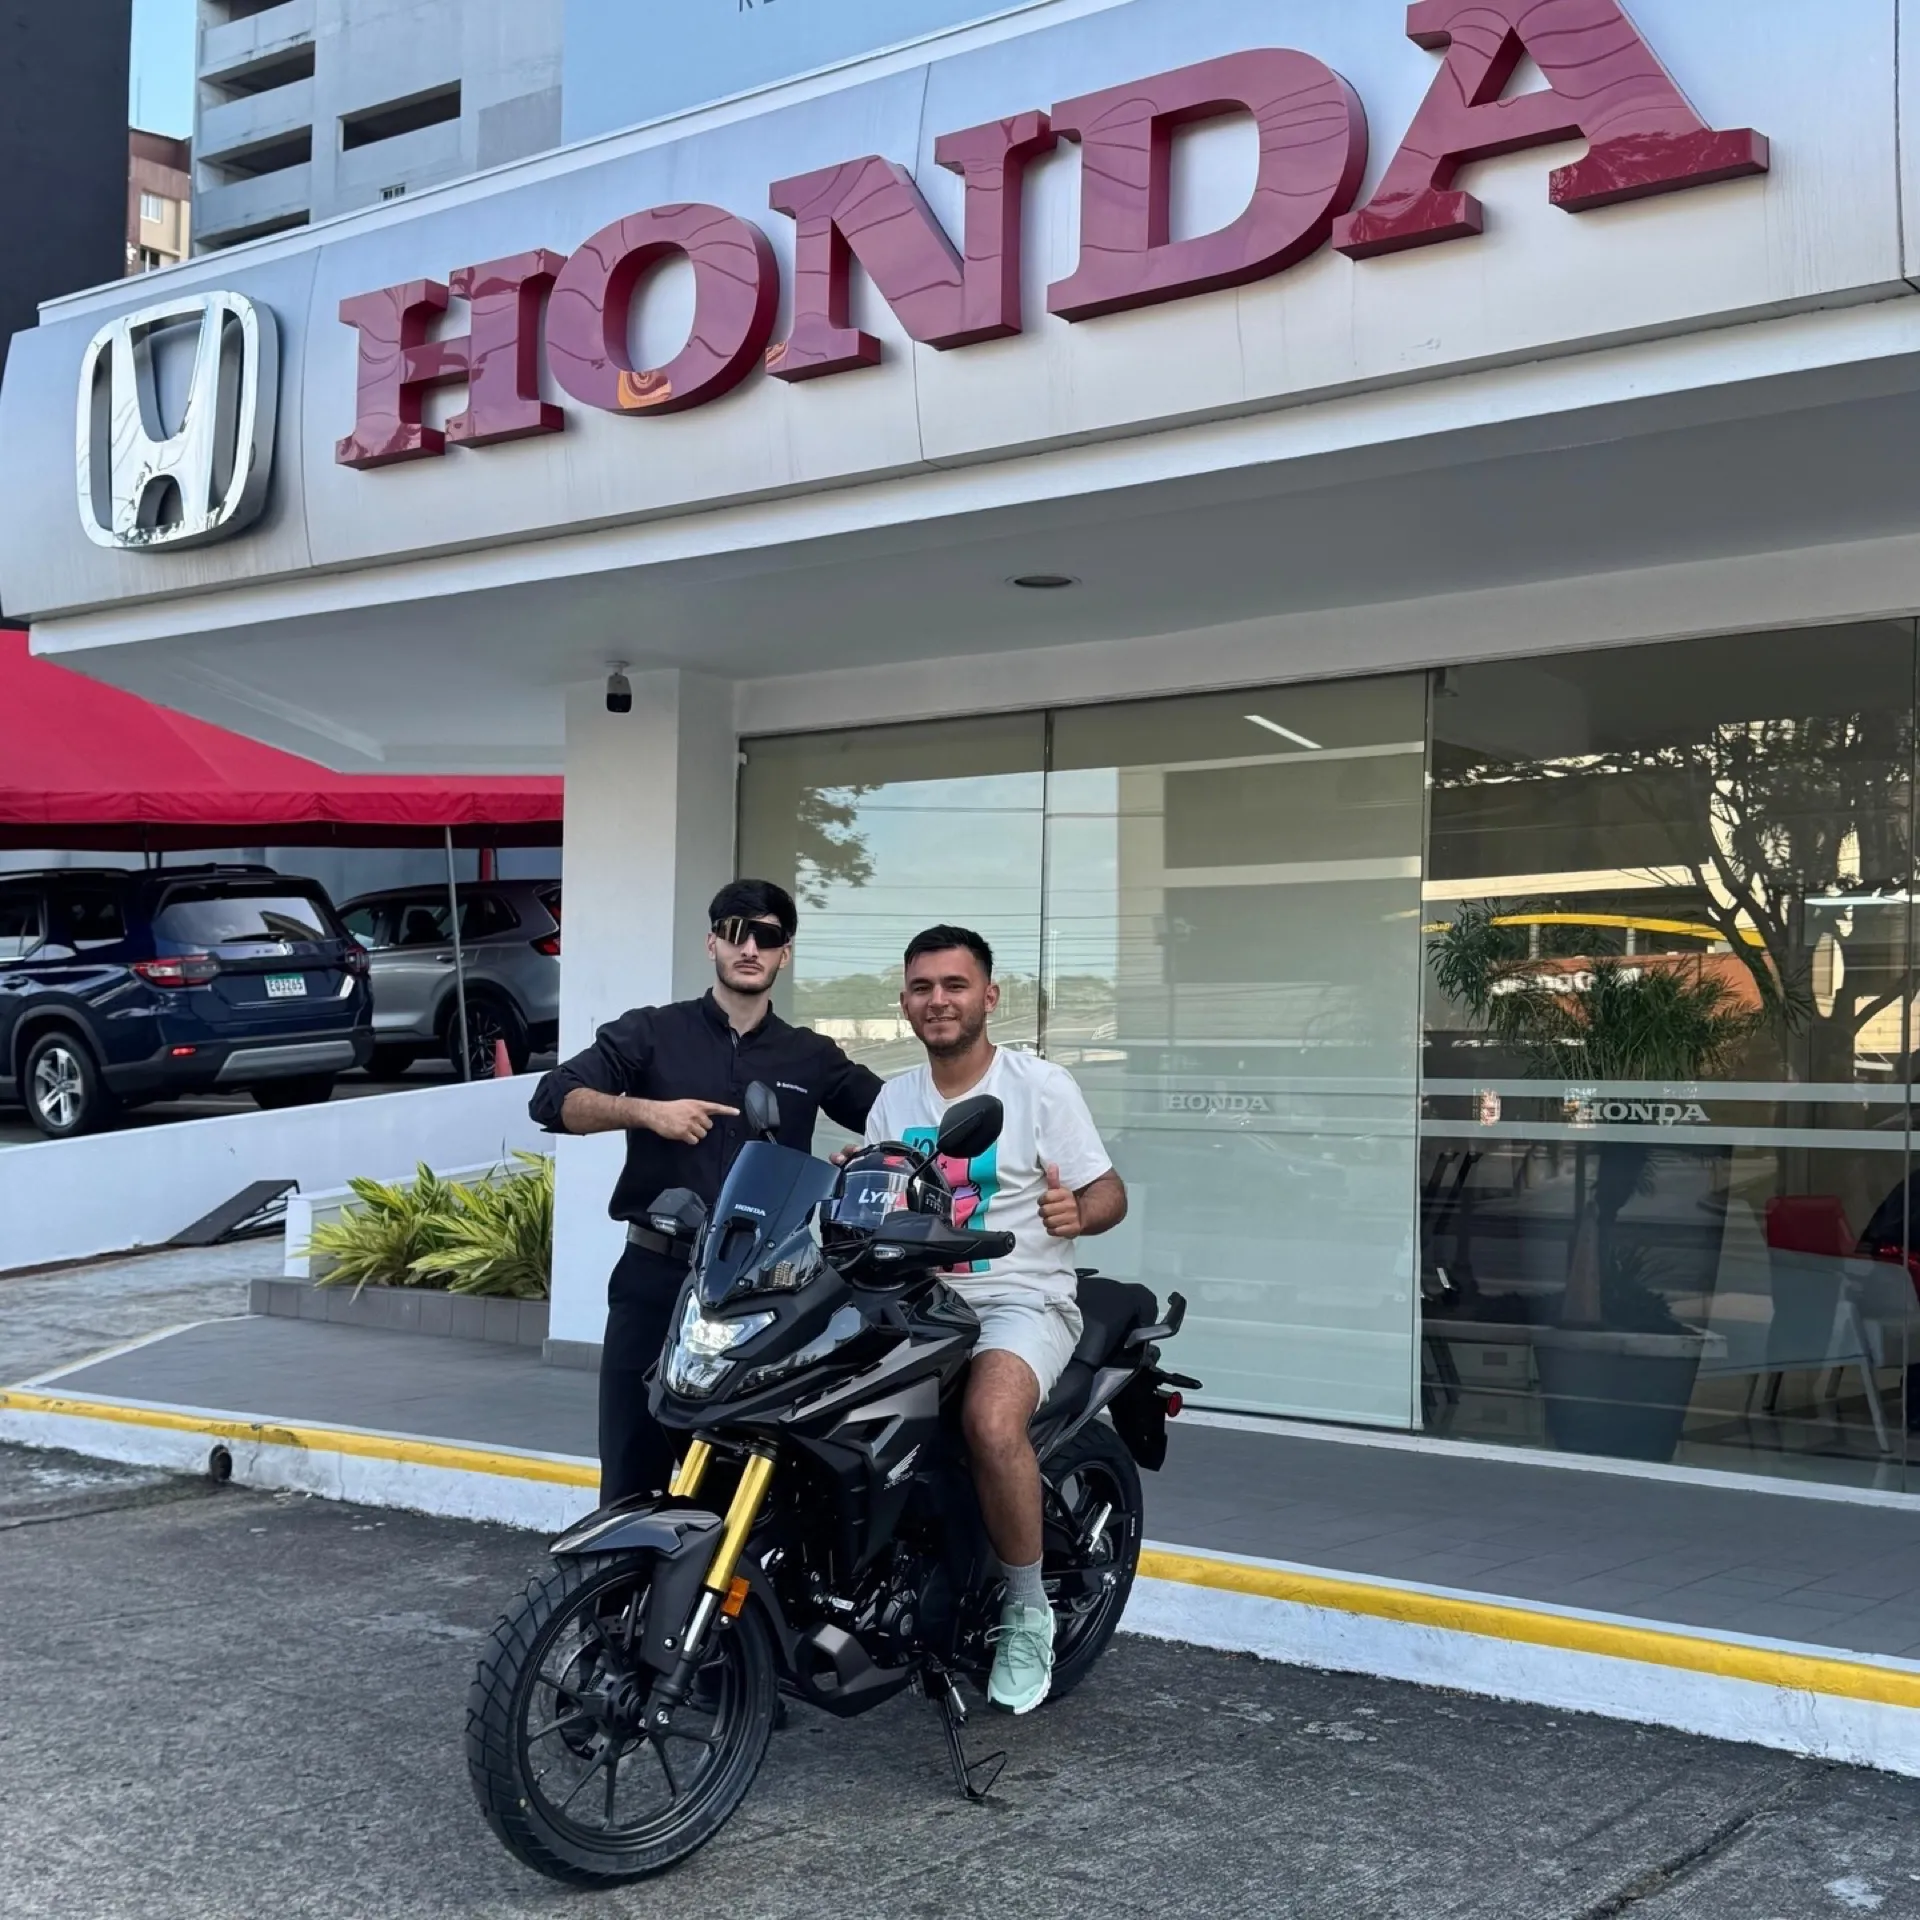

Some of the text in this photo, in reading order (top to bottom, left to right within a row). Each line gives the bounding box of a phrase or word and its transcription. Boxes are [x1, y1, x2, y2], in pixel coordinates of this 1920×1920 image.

[336, 0, 1768, 470] HONDA
[1168, 1093, 1271, 1112] HONDA
[1580, 1101, 1711, 1122] HONDA
